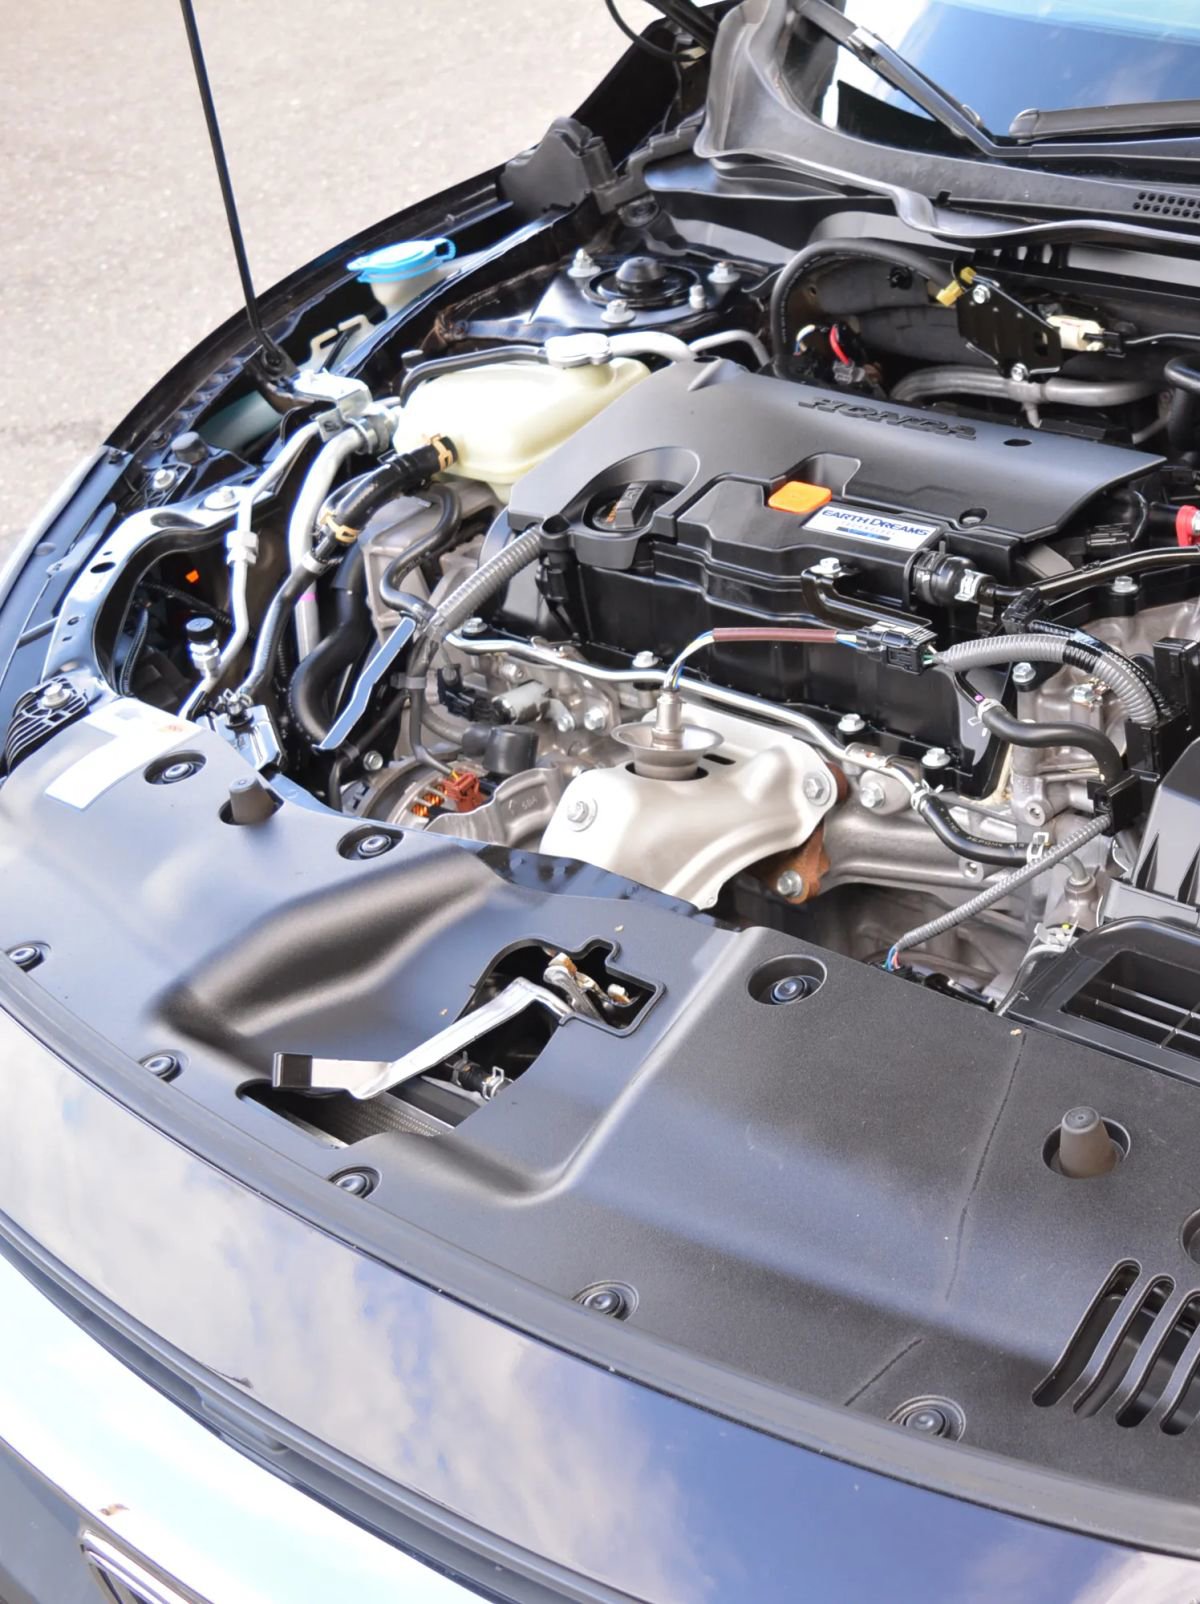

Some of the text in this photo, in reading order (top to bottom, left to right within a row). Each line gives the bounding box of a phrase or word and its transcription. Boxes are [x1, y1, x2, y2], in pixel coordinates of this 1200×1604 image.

[798, 396, 977, 441] HONDA
[821, 509, 868, 524] EARTH
[870, 518, 931, 536] DREAMS
